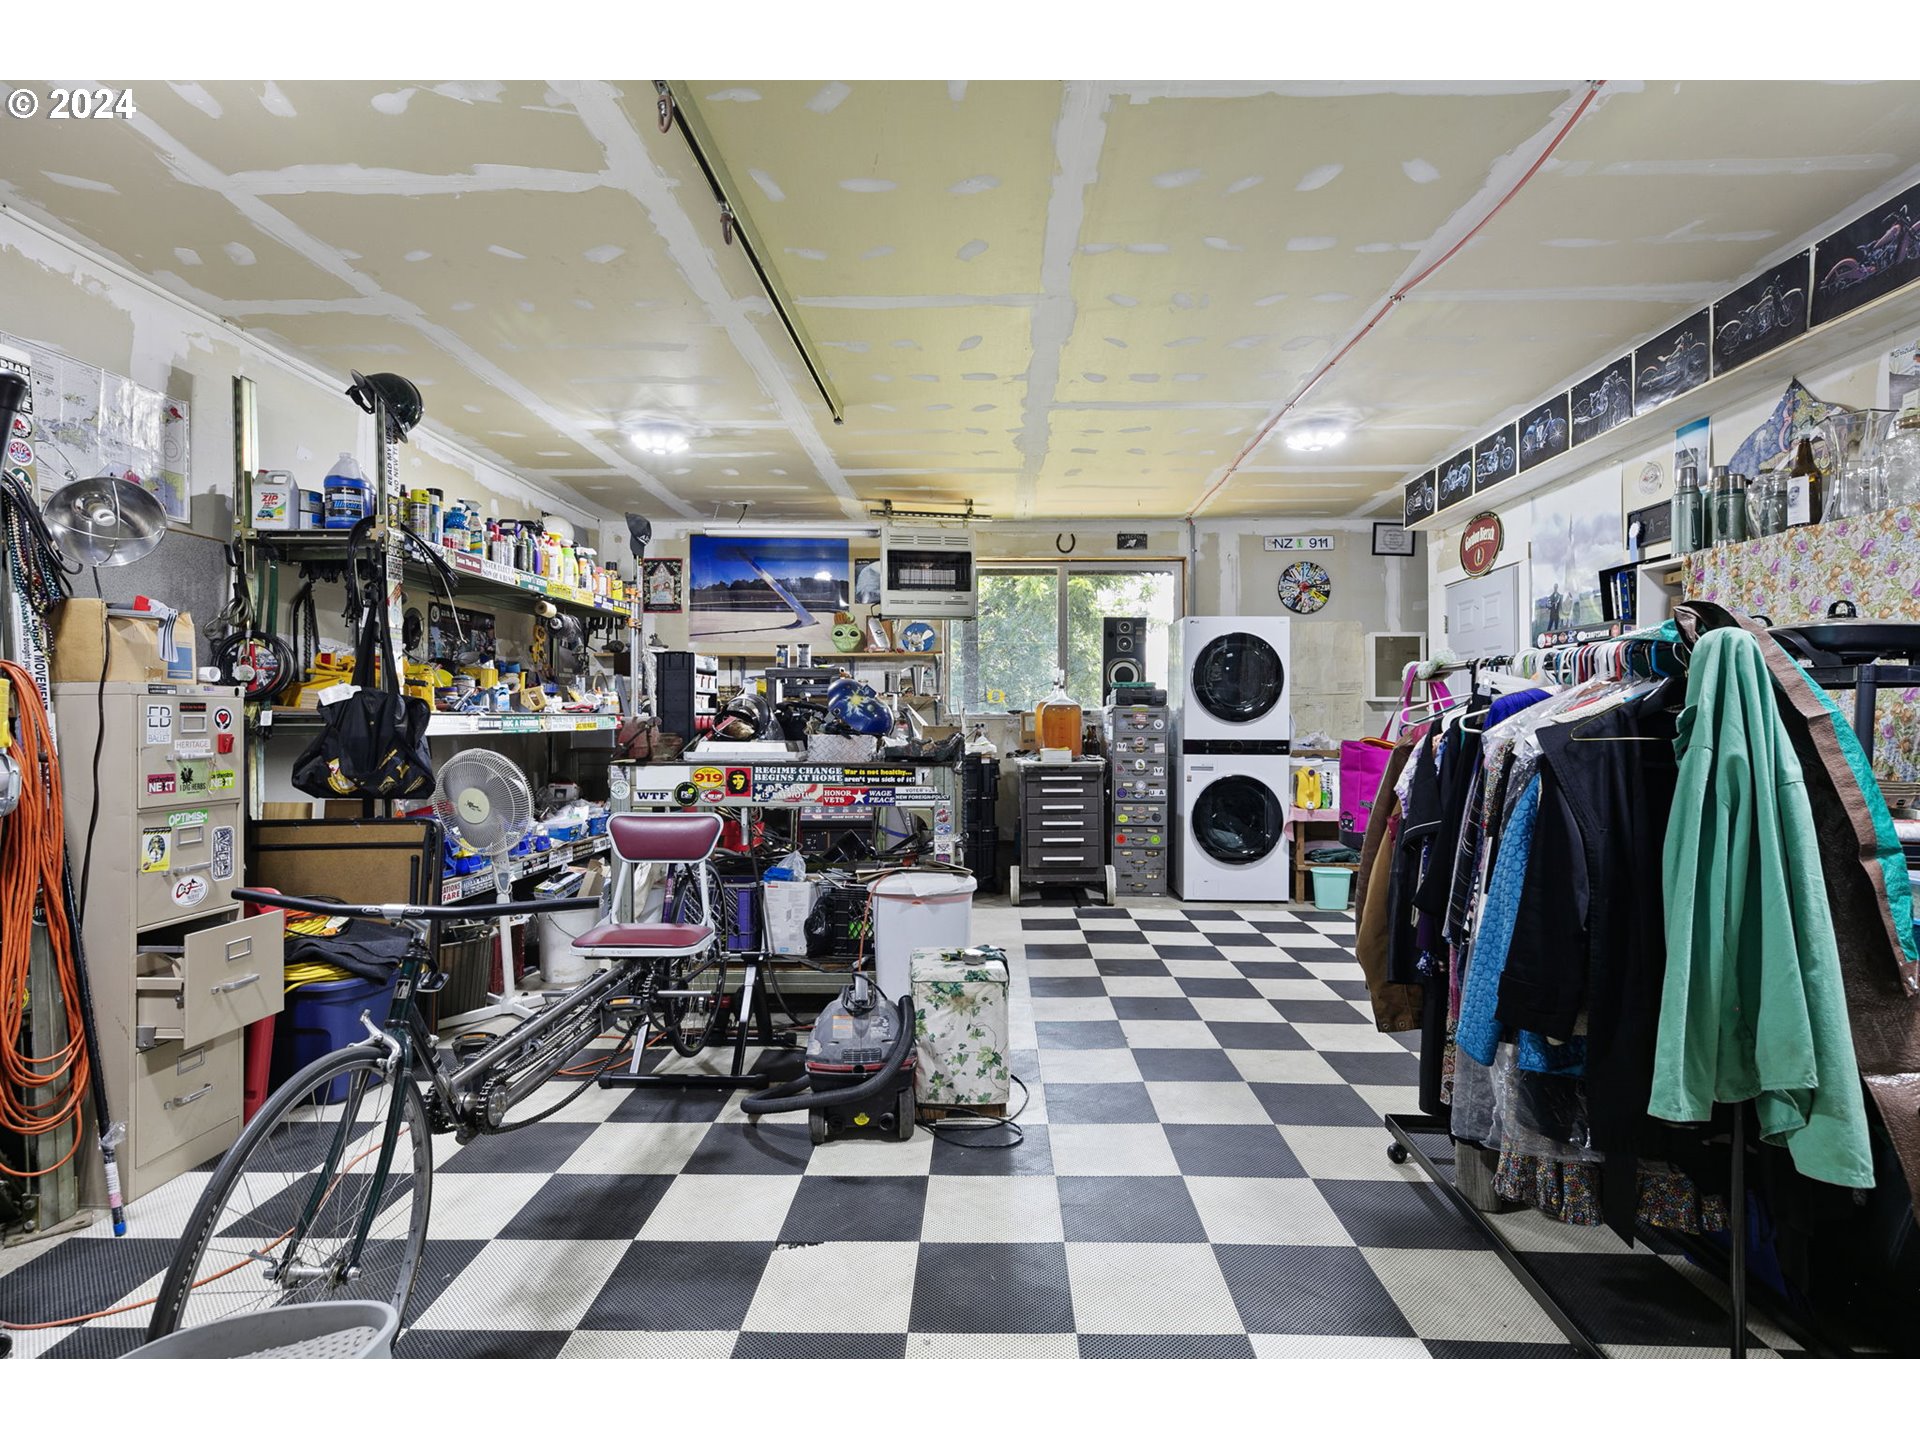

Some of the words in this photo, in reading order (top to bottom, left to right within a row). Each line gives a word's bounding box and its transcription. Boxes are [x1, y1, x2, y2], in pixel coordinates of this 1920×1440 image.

[1274, 538, 1293, 549] NZ
[1308, 538, 1328, 548] 911
[148, 734, 170, 742] BALLET
[176, 740, 209, 749] HERITAGE
[754, 766, 797, 774] REGIME
[798, 767, 843, 775] CHANGE
[694, 773, 723, 783] 919
[754, 774, 795, 782] BEGINS
[796, 774, 811, 782] AT
[811, 774, 843, 782] HOME
[148, 781, 175, 793] NEXT
[636, 792, 669, 800] WTF
[824, 789, 852, 797] HONOR
[168, 811, 208, 826] OPTIMISM
[173, 1204, 218, 1312] BONTRAGER
